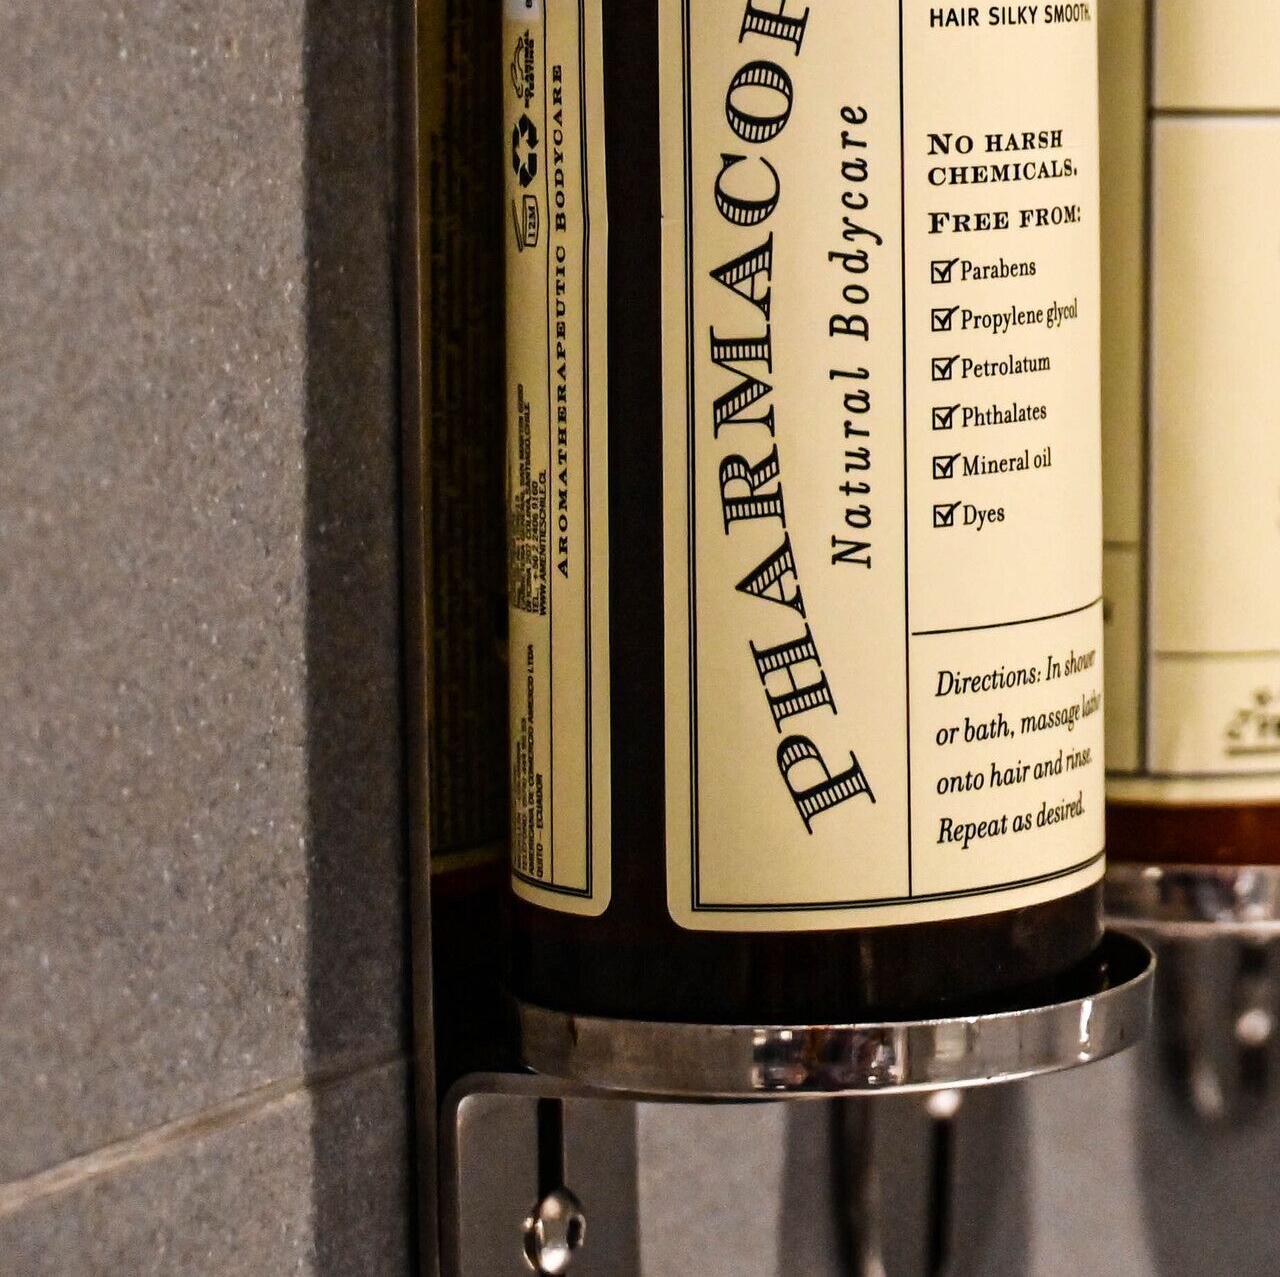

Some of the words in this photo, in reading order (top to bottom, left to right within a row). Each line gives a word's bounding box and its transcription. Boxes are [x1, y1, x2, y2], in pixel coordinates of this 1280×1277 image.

[930, 6, 980, 27] HAIR
[988, 5, 1038, 26] SILKY
[552, 64, 566, 233] BODYCARE
[927, 133, 974, 156] NO
[985, 129, 1063, 152] HARSH
[927, 158, 1078, 186] CHEMICALS.
[527, 205, 536, 238] 12M
[829, 105, 884, 341] Bodycare
[928, 211, 1009, 235] FREE
[1019, 204, 1081, 228] FROM:
[960, 258, 1037, 281] Parabens
[961, 305, 1044, 335] Propylene
[1047, 297, 1078, 329] glycol
[961, 354, 1051, 379] Petrolatum
[555, 244, 569, 579] AROMATHERAPEUTIC
[962, 402, 1047, 428] Phthalates
[830, 366, 872, 569] Natural
[962, 449, 1030, 478] Mineral
[1034, 446, 1052, 469] oil
[962, 504, 1005, 532] Dyes
[935, 665, 1041, 697] Directions:
[1045, 655, 1061, 681] In
[935, 726, 959, 746] or
[964, 713, 1015, 743] bath,
[1021, 703, 1081, 734] massage
[936, 771, 984, 795] onto
[990, 760, 1030, 788] hair
[1033, 750, 1063, 780] and
[937, 814, 1008, 850] Repeat
[1012, 814, 1032, 833] as
[1036, 791, 1085, 828] desired.
